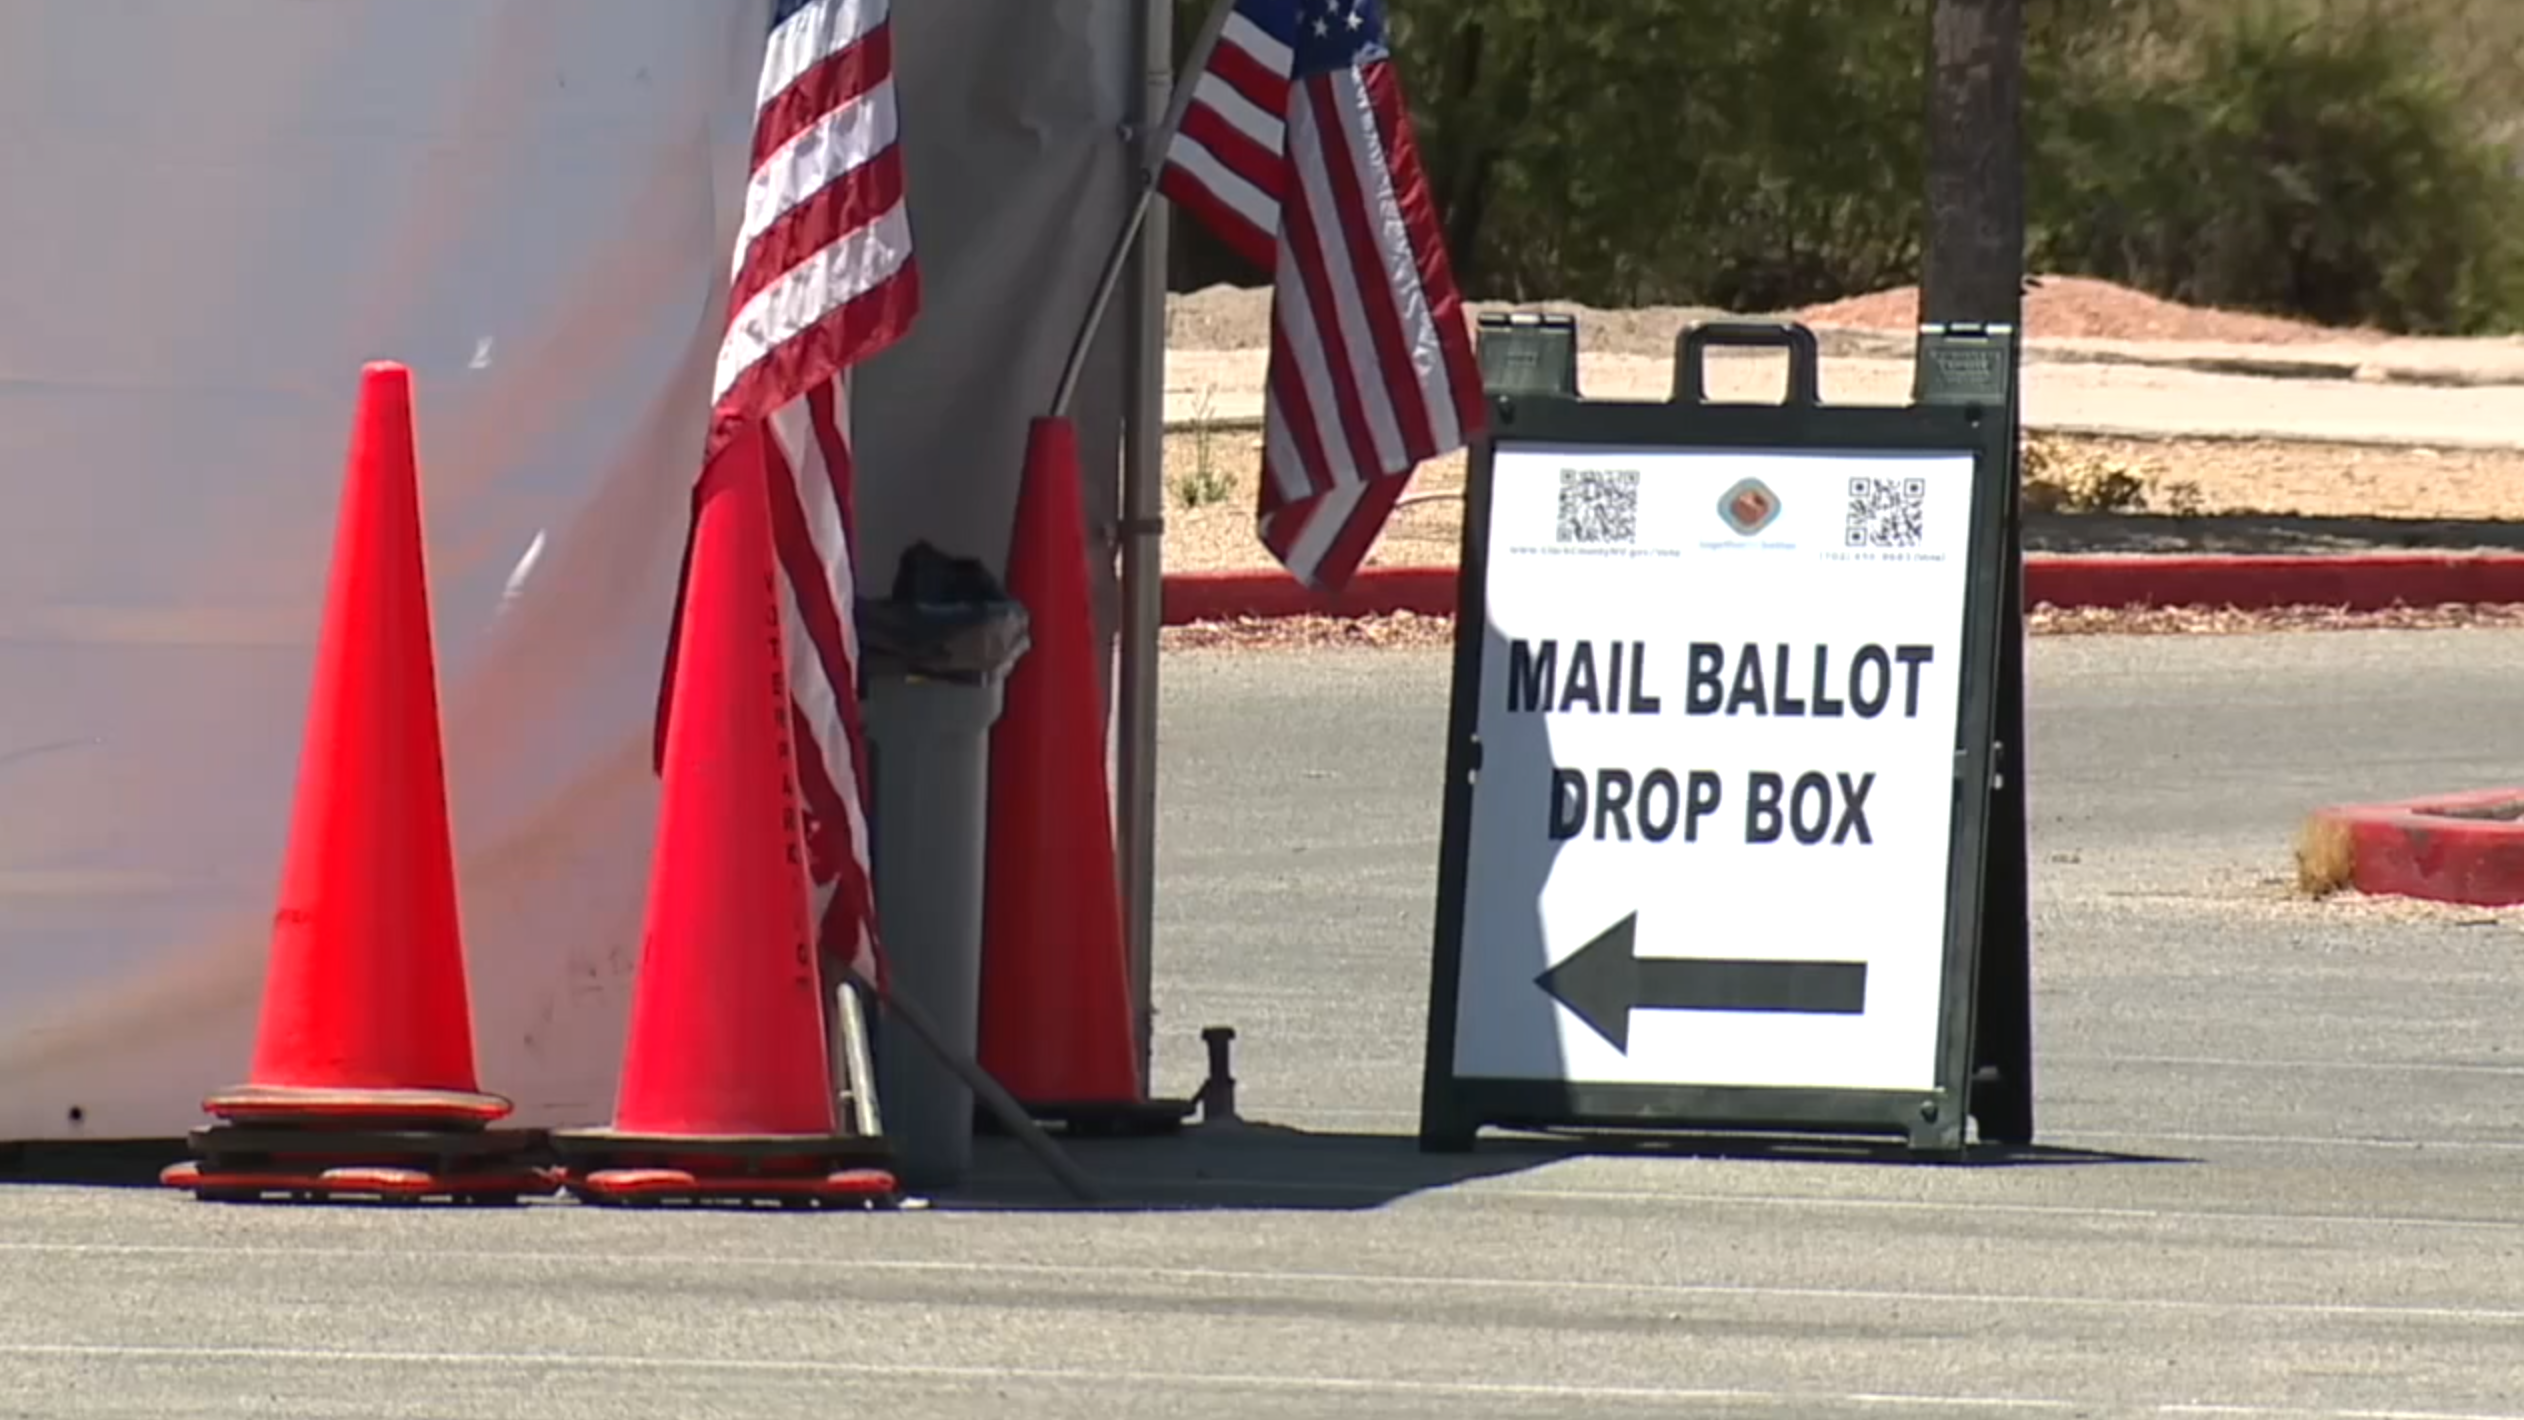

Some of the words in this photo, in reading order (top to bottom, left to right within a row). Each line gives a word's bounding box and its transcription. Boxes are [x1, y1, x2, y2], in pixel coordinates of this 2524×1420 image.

[1507, 640, 1661, 715] MAIL
[1685, 642, 1934, 719] BALLOT
[1548, 767, 1722, 843] DROP
[1745, 771, 1877, 845] BOX
